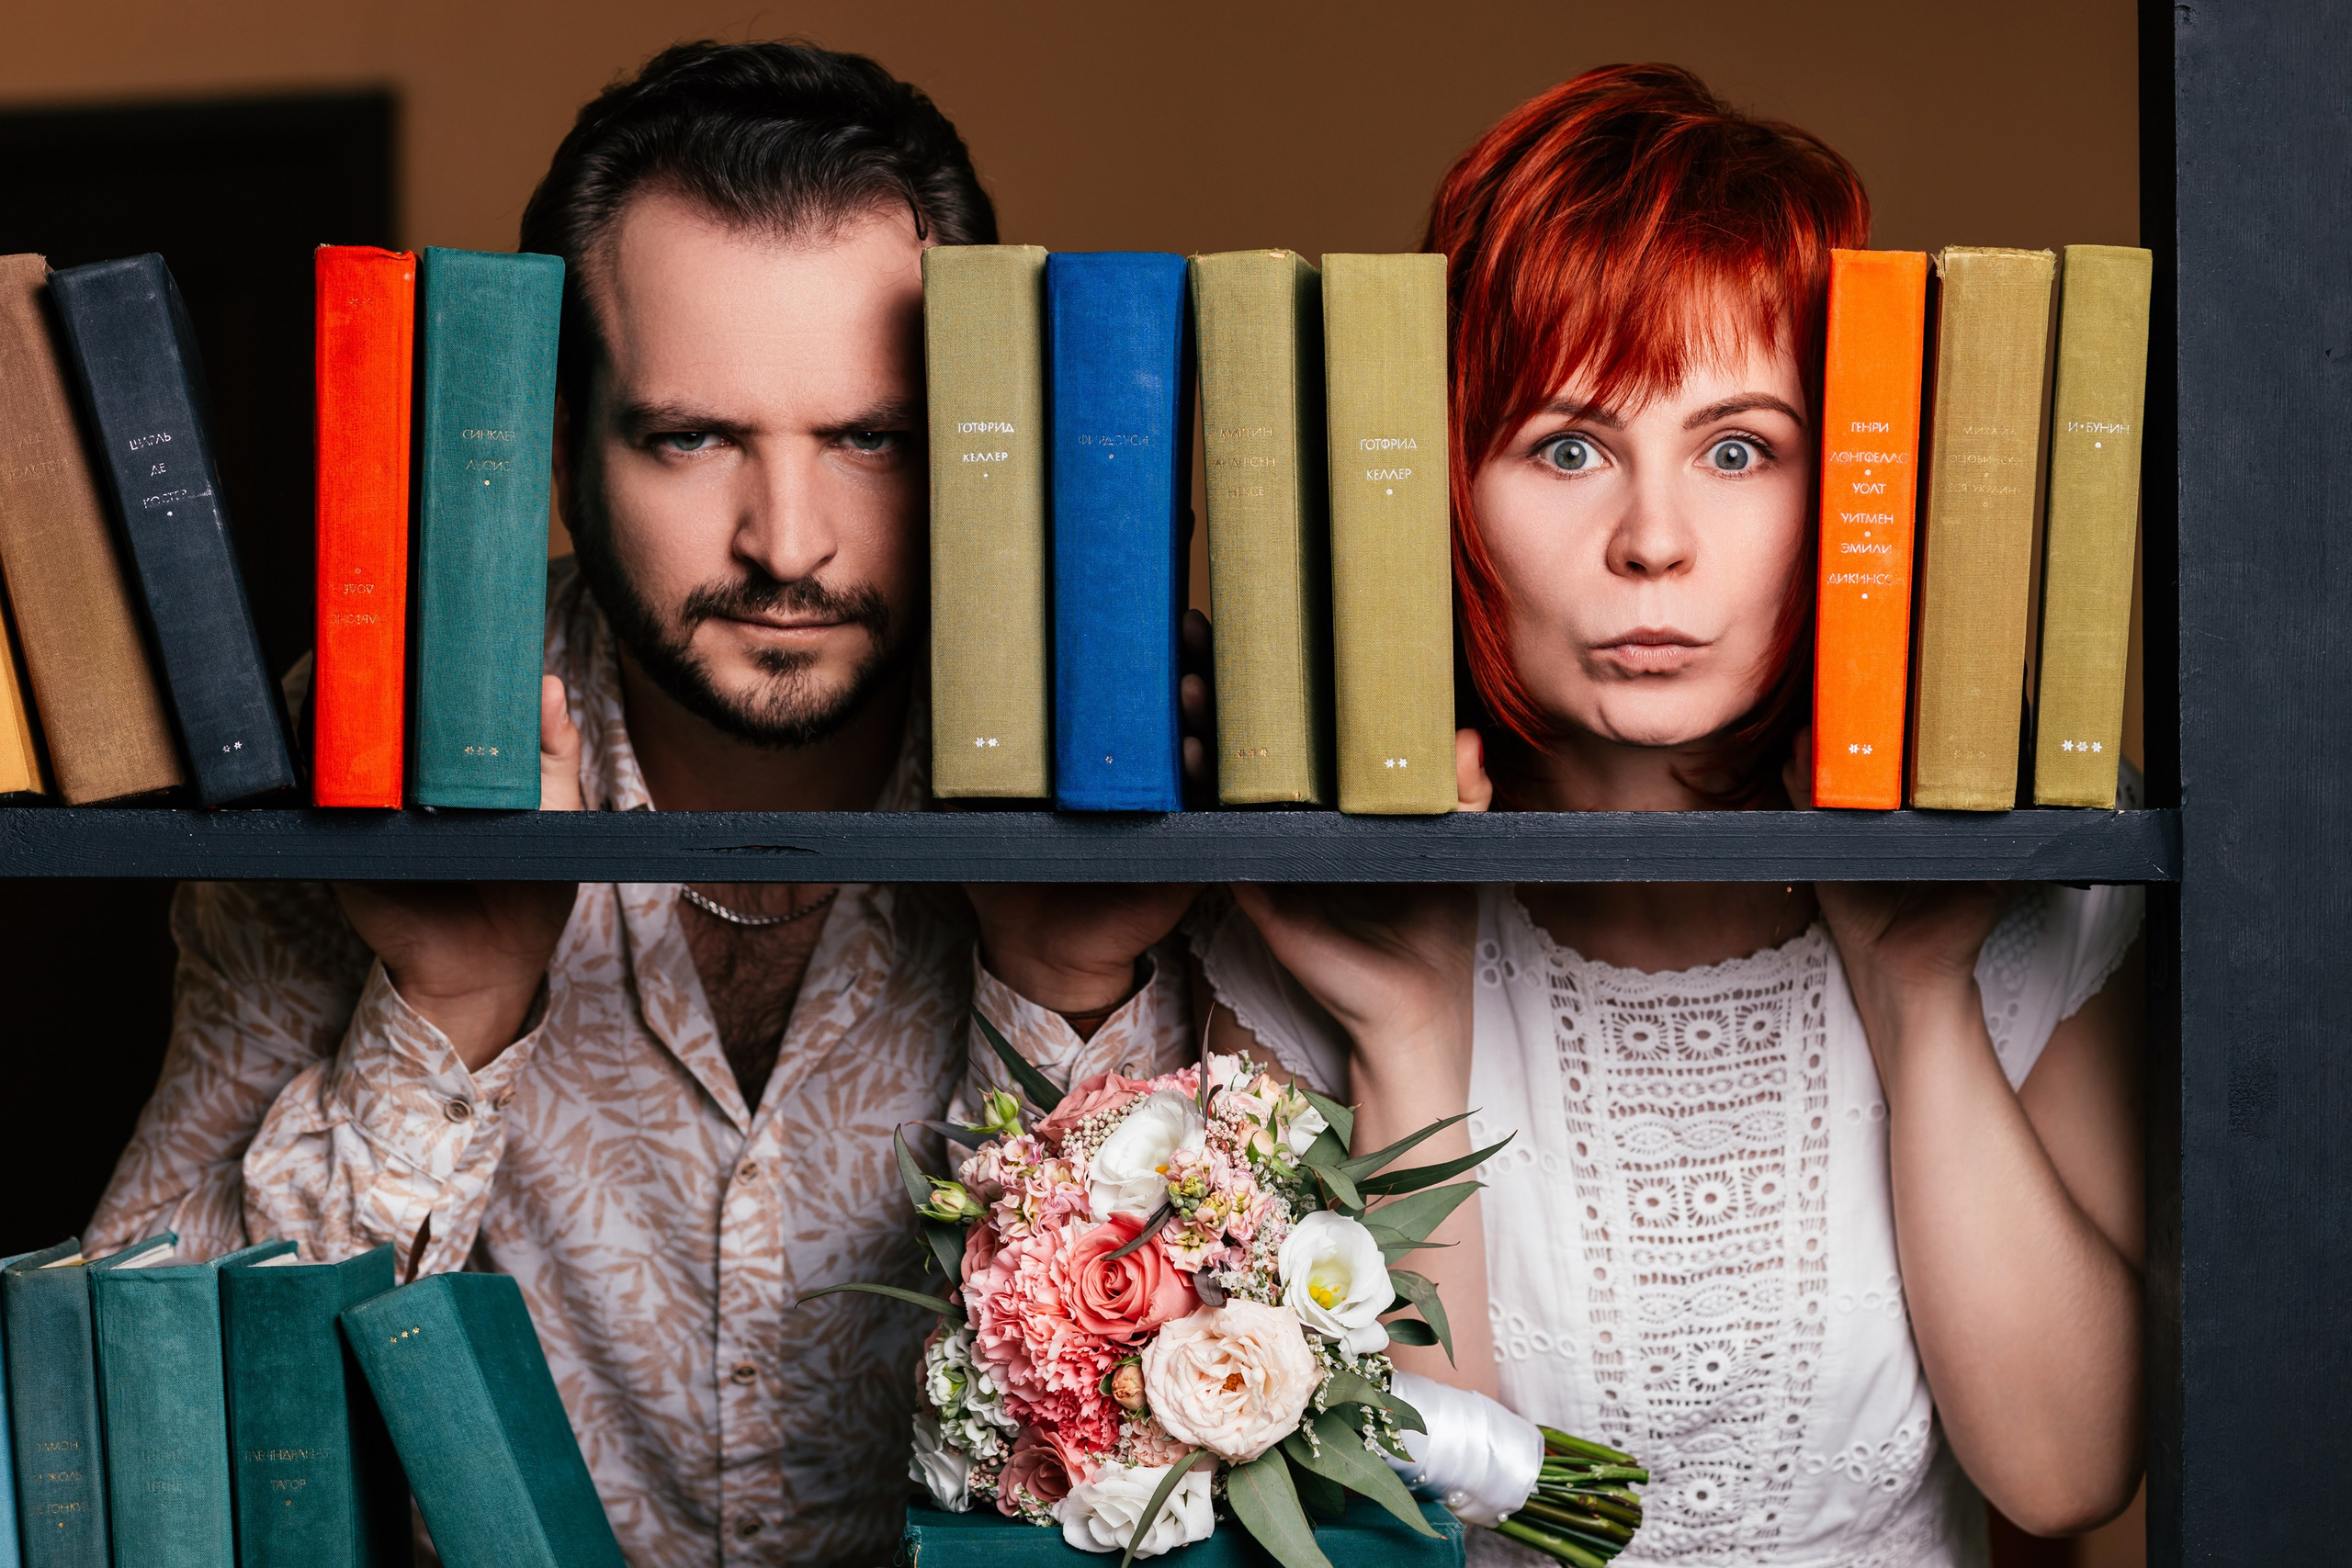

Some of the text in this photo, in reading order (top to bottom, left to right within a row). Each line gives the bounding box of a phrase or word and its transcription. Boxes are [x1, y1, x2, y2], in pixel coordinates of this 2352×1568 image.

[957, 422, 1015, 434] ГОТФРИД
[1850, 422, 1889, 433] ГЕНРИ
[462, 429, 515, 441] СИНКЛЕР
[1360, 437, 1418, 451] ГОТФРИД
[963, 452, 1009, 462] КЕЛЛЕР
[1829, 451, 1910, 464] ЛОНГФЕЛЛО
[1366, 468, 1412, 480] КЕЛЛЕР
[1852, 482, 1887, 494] УОЛТ
[1840, 513, 1894, 525] УИТМЕН
[1840, 542, 1893, 555] ЭМИЛИ
